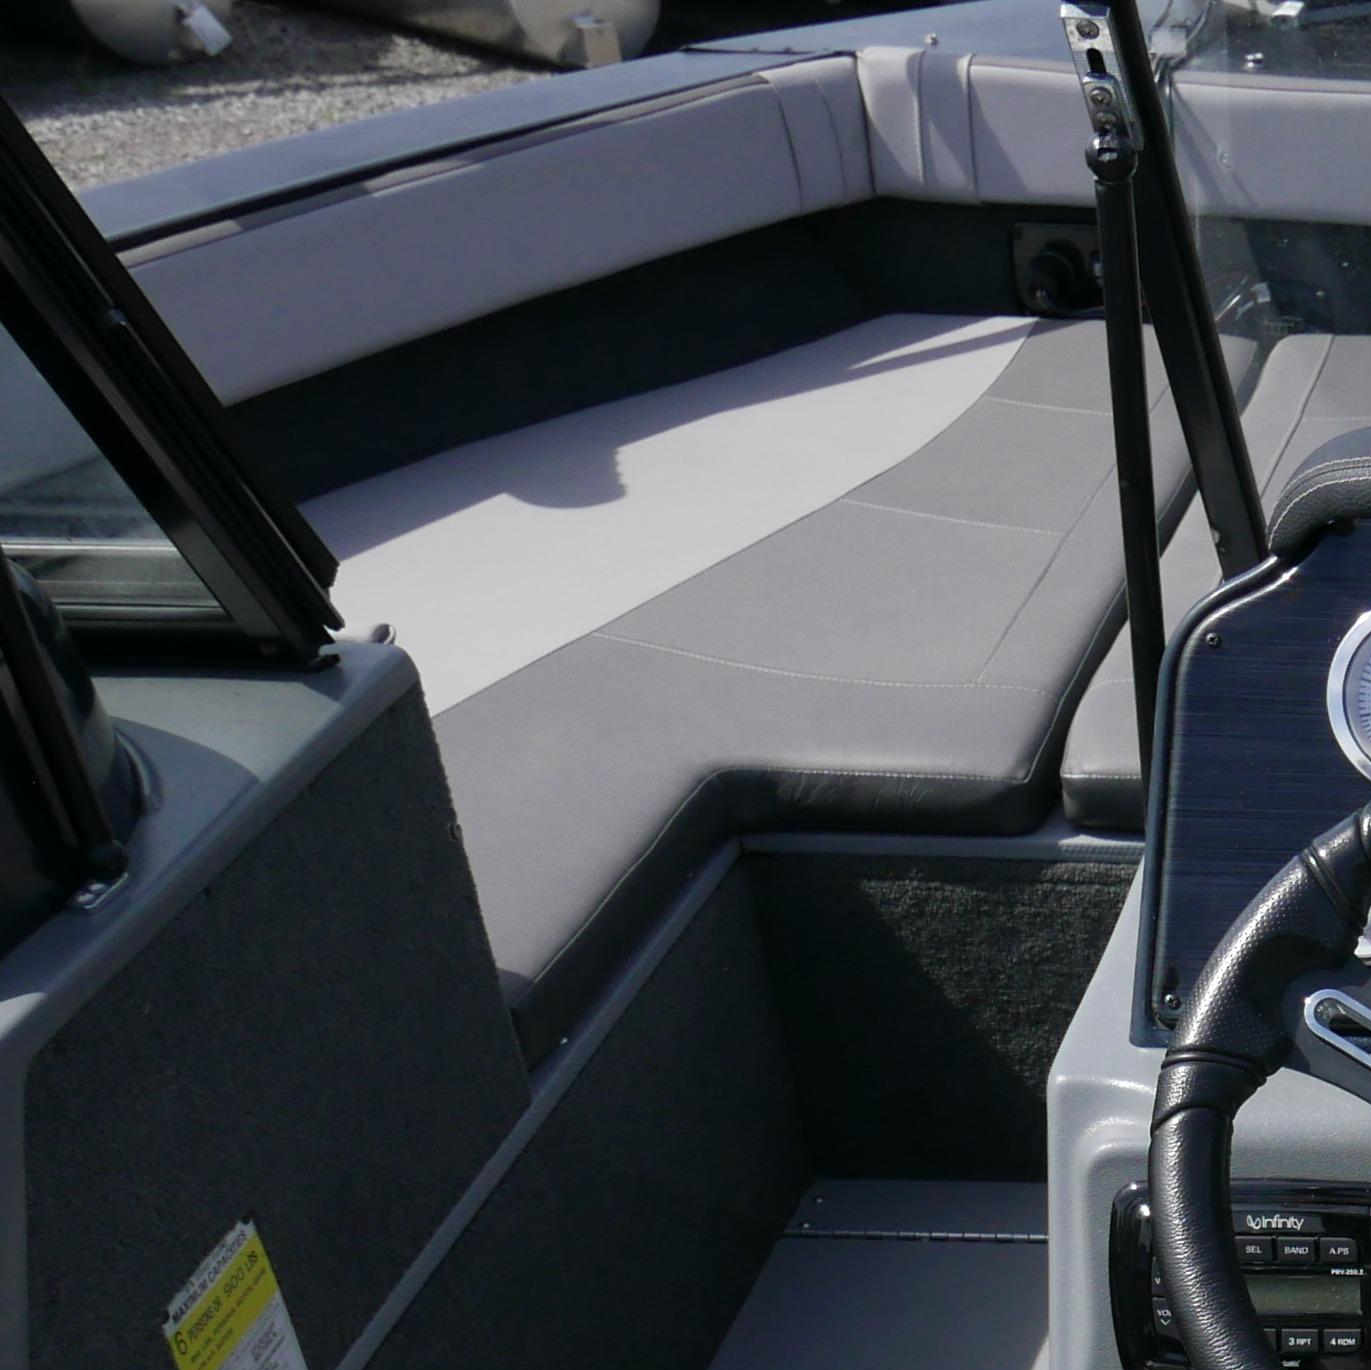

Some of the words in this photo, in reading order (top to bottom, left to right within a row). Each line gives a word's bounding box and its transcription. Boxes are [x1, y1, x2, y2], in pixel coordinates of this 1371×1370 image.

[1246, 1245, 1262, 1254] SEL
[1284, 1246, 1309, 1255] BAND
[174, 1331, 188, 1356] 6
[1288, 1338, 1295, 1346] 3
[1330, 1338, 1337, 1346] 4
